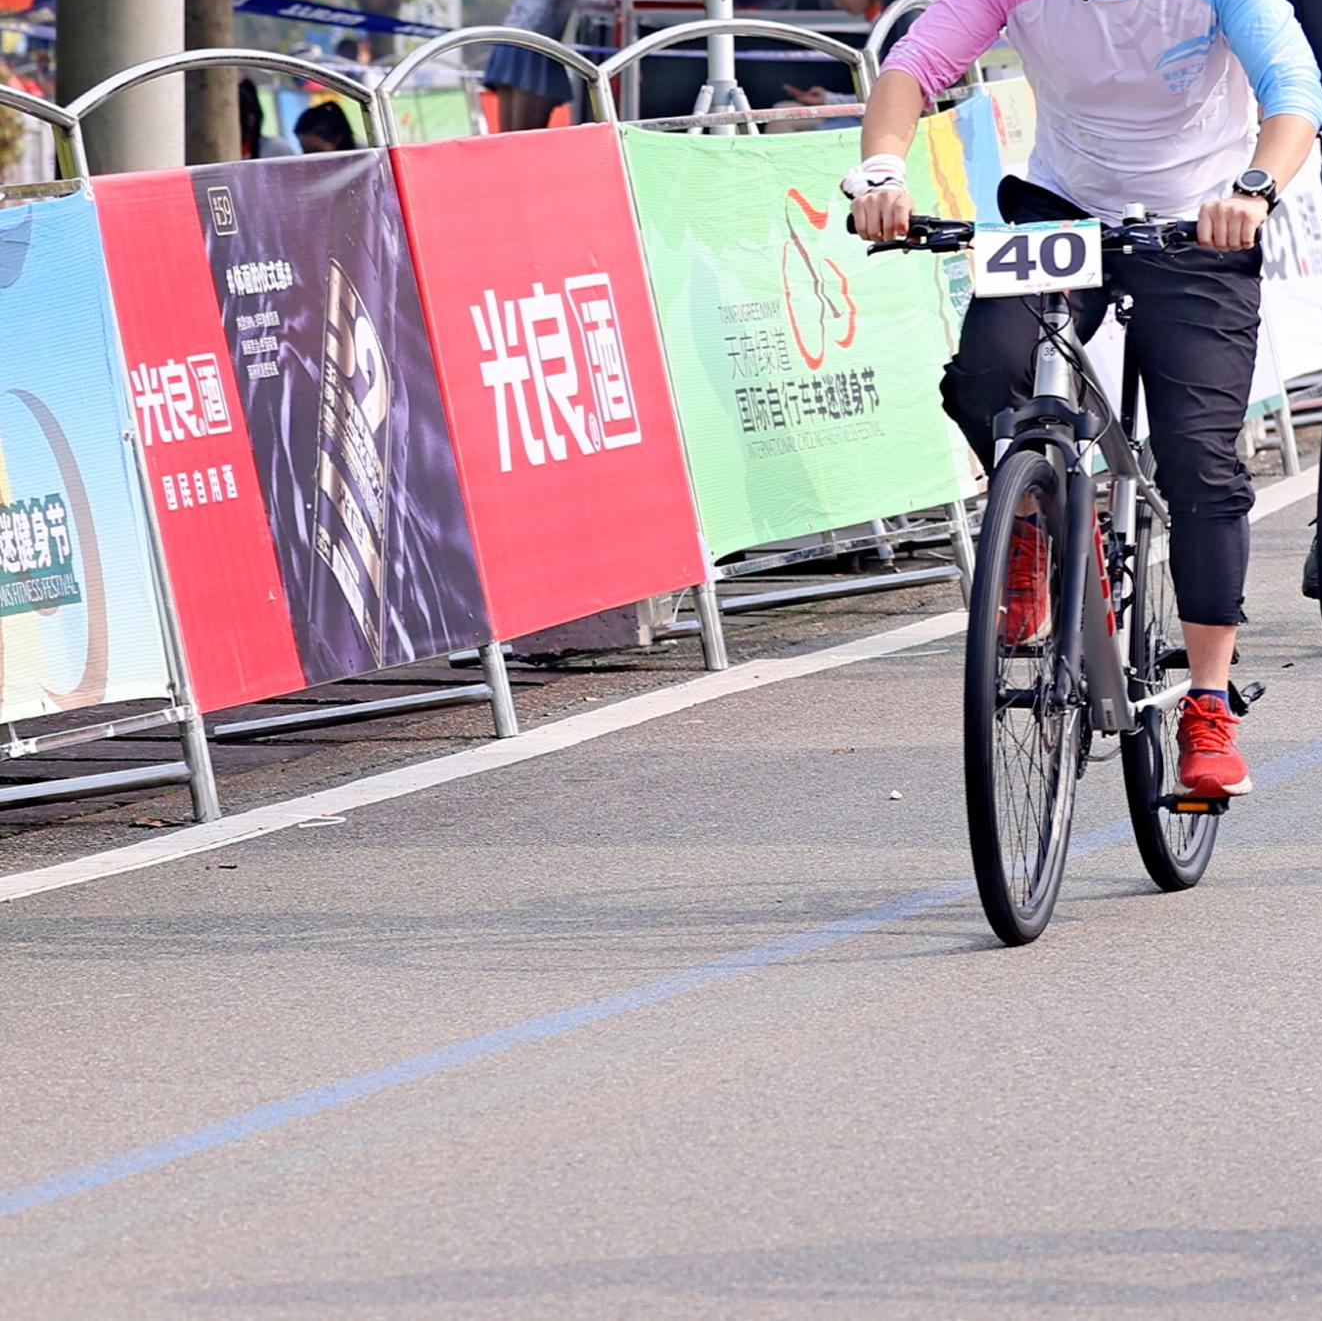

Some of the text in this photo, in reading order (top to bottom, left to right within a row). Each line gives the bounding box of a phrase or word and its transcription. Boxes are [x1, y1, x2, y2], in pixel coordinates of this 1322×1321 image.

[986, 232, 1086, 281] 40
[724, 329, 792, 380] 天府绿道
[735, 365, 880, 435] 国际自行车车迷健身节
